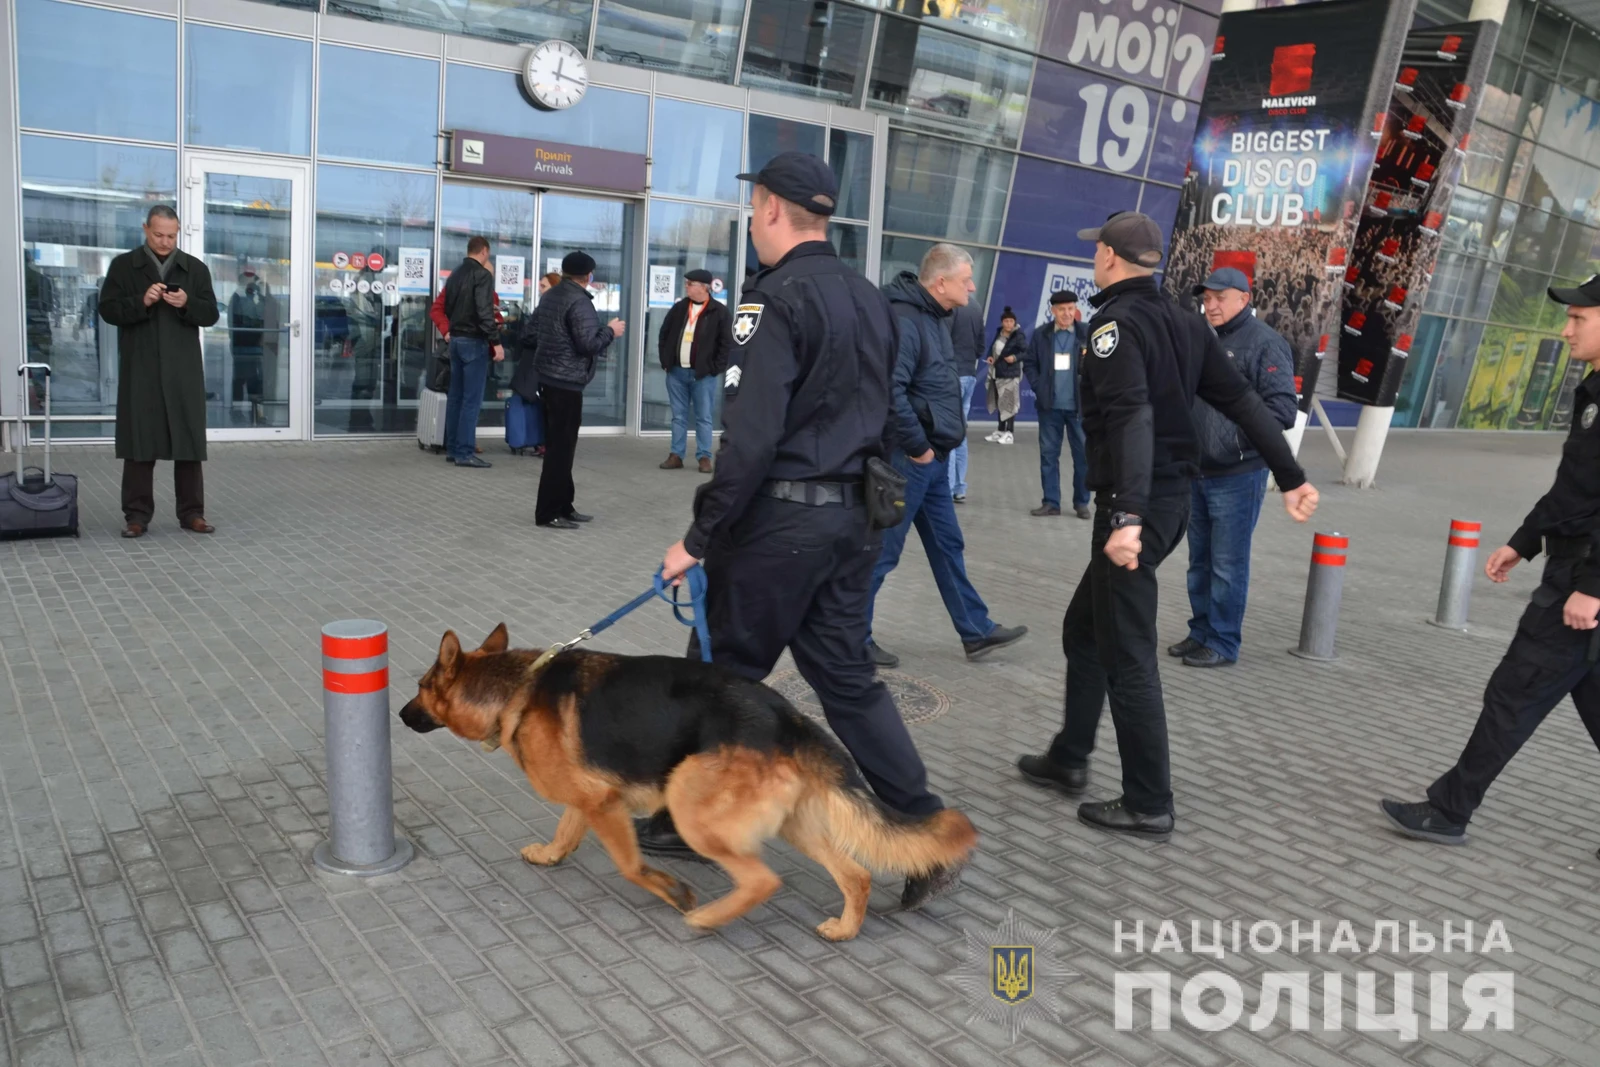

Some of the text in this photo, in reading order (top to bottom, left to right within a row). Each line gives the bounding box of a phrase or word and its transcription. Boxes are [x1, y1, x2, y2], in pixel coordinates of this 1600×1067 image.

[1262, 96, 1317, 108] MALEVICH
[1079, 83, 1150, 173] 19
[1232, 129, 1330, 153] BIGGEST
[535, 149, 573, 162] Приліт
[534, 162, 573, 175] Arrivals
[1223, 158, 1318, 187] DISCO
[1211, 192, 1304, 226] CLUB
